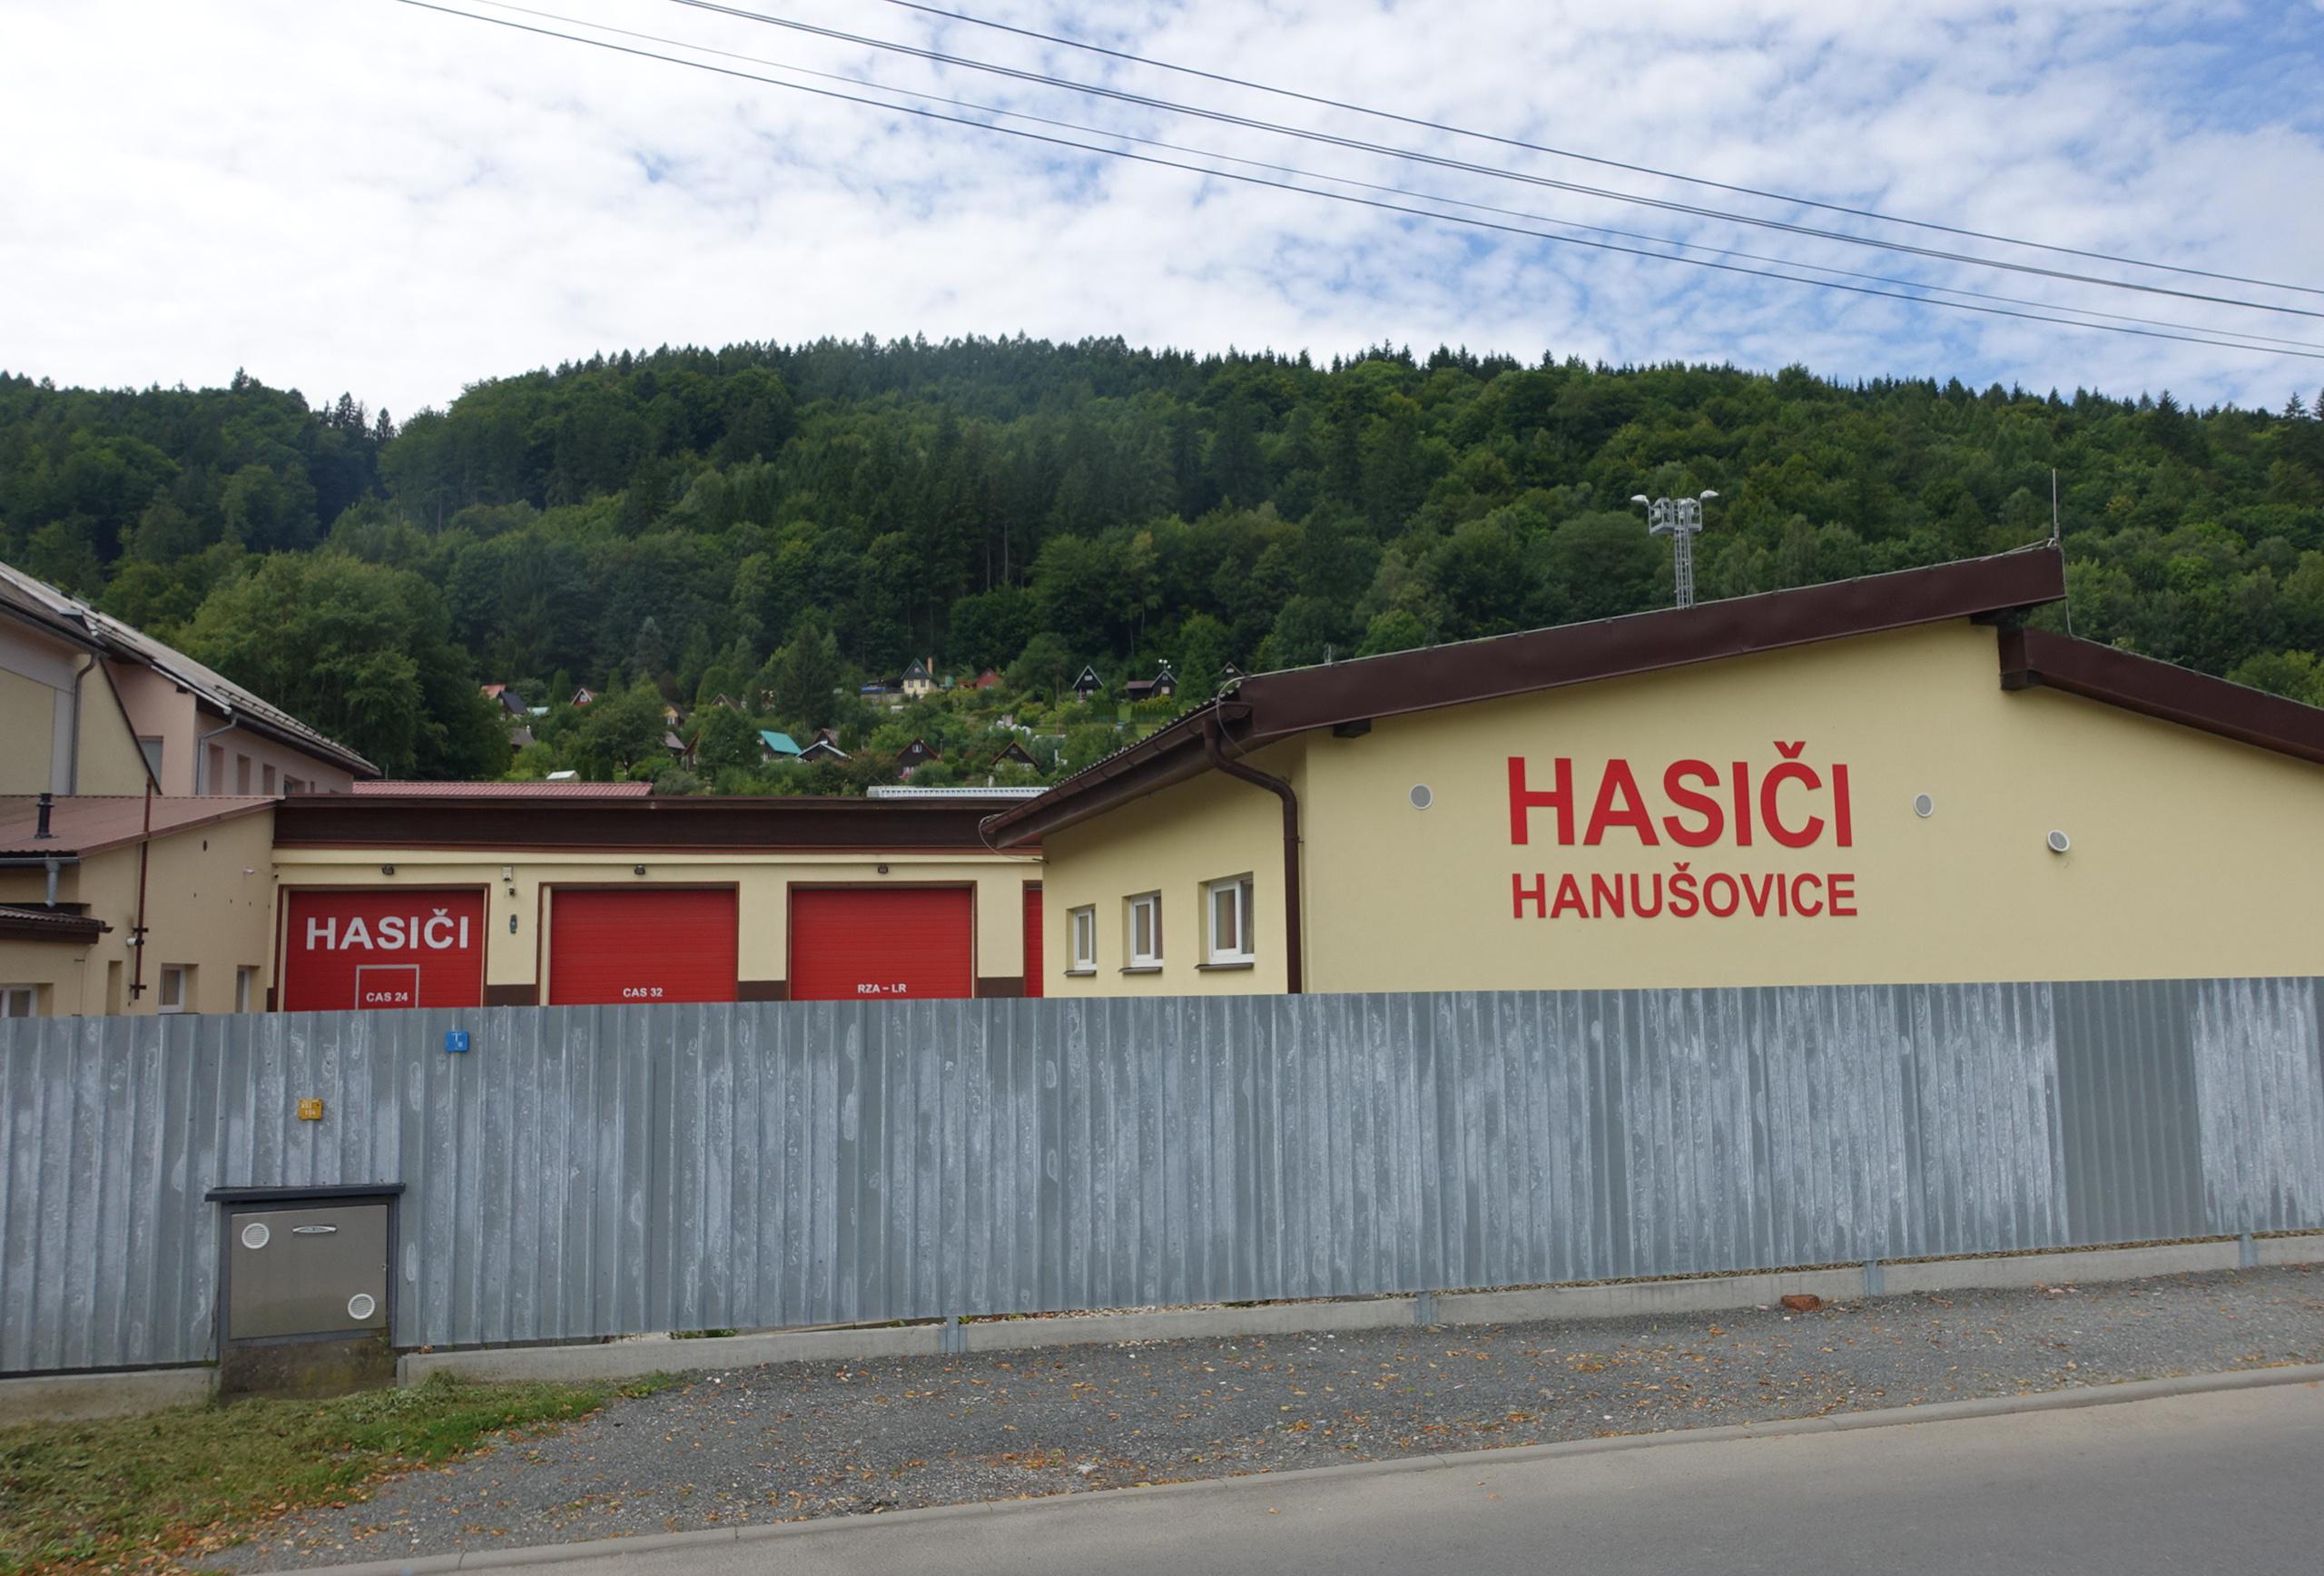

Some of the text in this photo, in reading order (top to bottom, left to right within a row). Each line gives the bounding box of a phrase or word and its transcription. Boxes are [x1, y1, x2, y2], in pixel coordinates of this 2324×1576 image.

[1508, 740, 1853, 848] HASIČI
[1512, 862, 1857, 919] HANUŠOVICE
[306, 908, 469, 951] HASIČI
[366, 991, 409, 1002] CAS 24
[623, 987, 664, 998] CAS 32
[857, 983, 881, 994] RZA
[891, 983, 907, 993] LR
